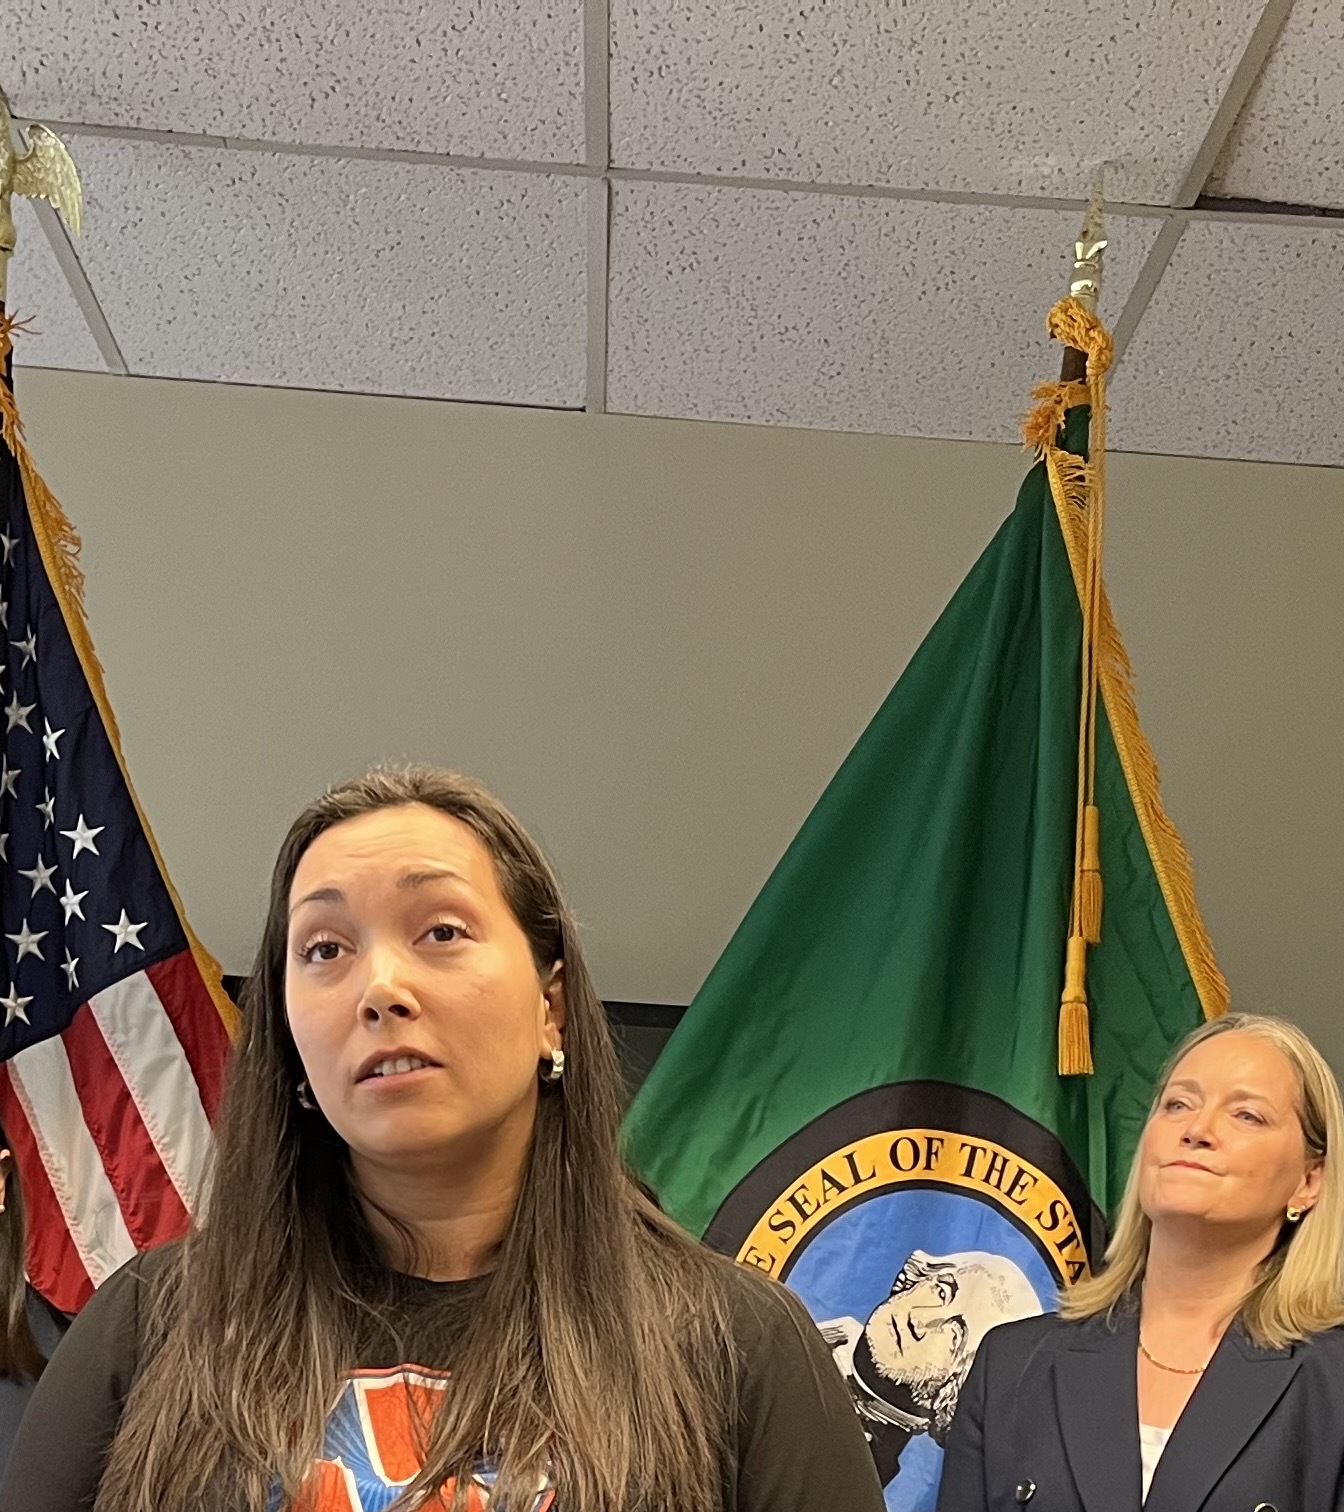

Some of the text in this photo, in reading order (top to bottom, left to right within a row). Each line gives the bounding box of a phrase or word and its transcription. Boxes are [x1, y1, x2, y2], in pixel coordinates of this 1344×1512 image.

[768, 1136, 1086, 1286] SEAL OF THE STA
